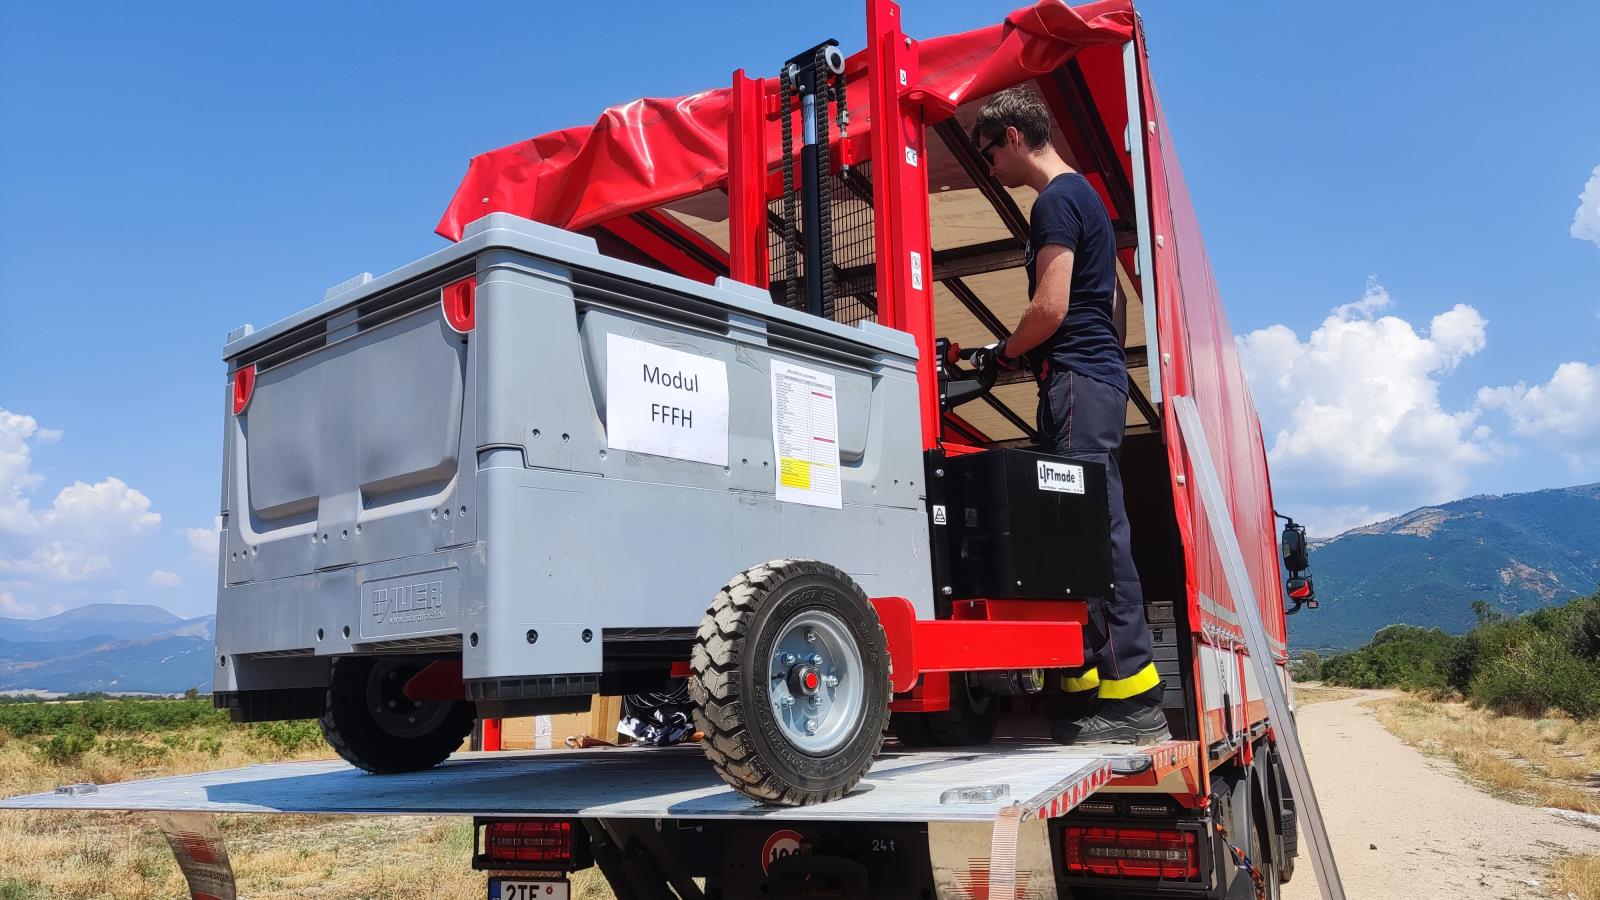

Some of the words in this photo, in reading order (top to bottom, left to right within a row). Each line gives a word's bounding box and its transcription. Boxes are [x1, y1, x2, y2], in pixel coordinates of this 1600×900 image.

[642, 363, 699, 393] Modul
[651, 403, 693, 429] FFFH
[872, 839, 887, 852] 24
